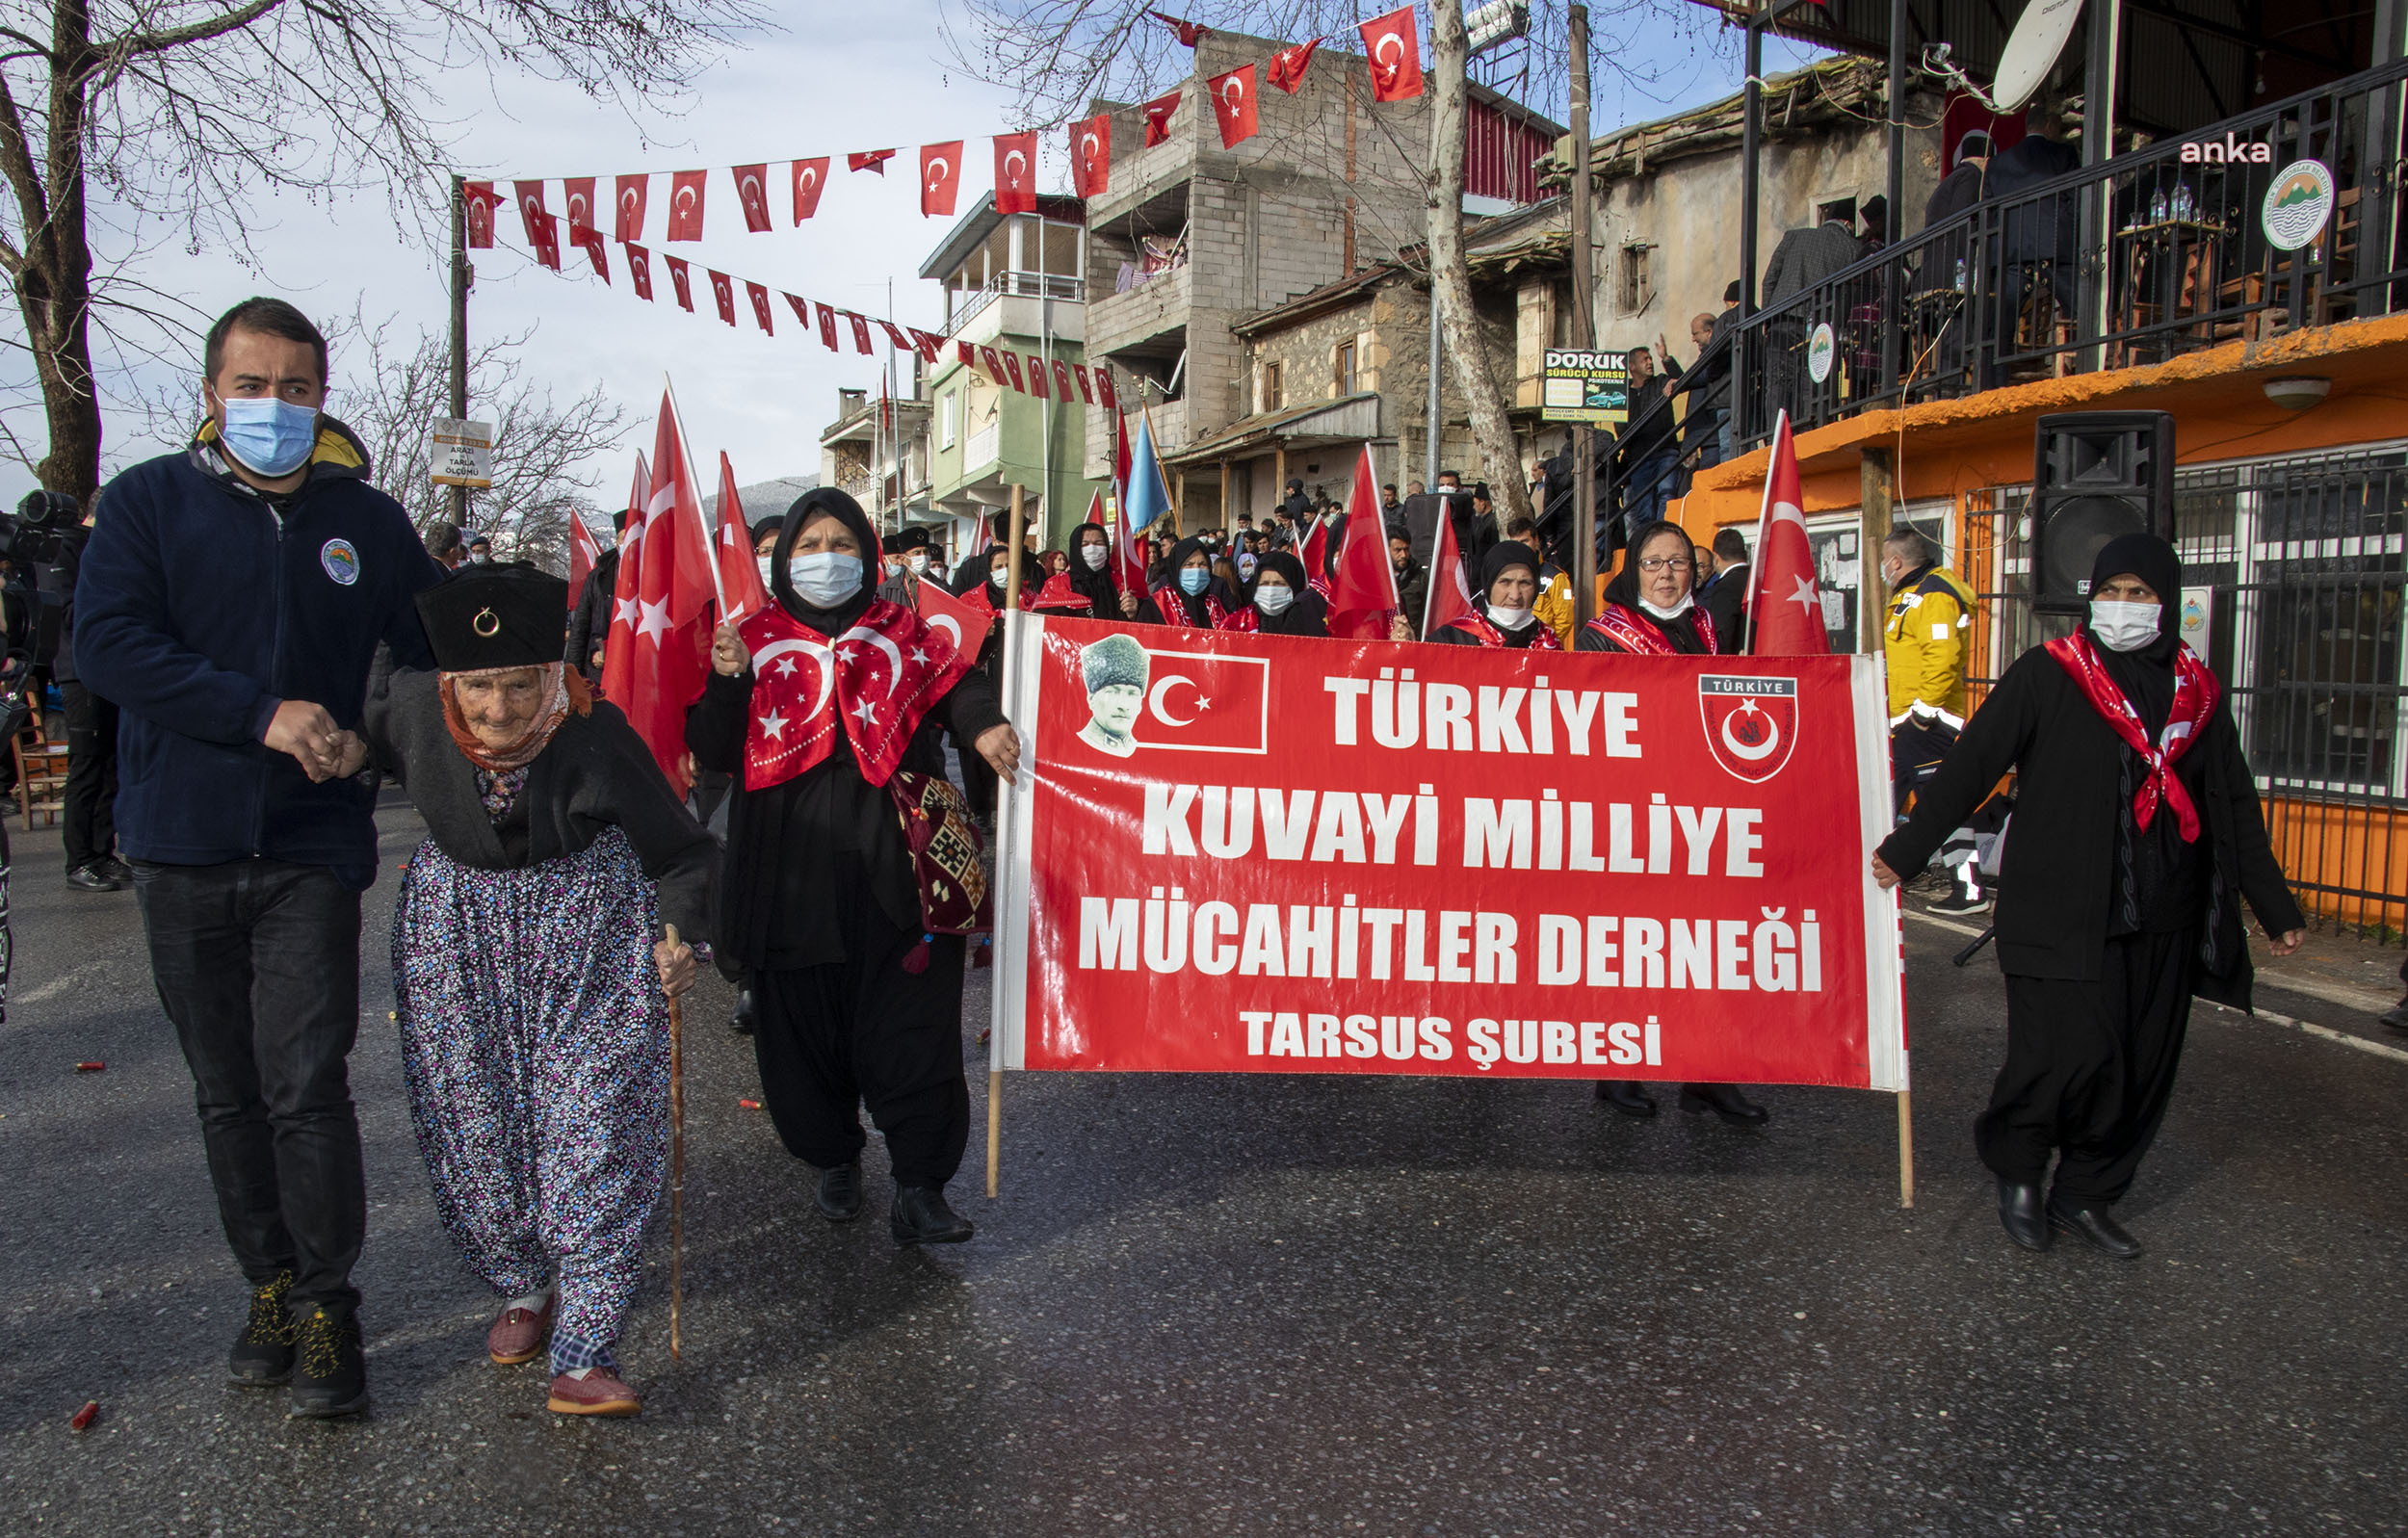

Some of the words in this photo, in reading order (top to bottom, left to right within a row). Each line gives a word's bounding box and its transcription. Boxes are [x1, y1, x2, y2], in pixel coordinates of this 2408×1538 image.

[1546, 352, 1626, 370] DORUK
[1546, 368, 1589, 378] SÜRÜCÜ
[450, 446, 474, 455] ARAZİ
[445, 467, 479, 476] ÖLÇÜMÜ
[1713, 679, 1784, 693] TÜRKİYE
[1324, 667, 1641, 758] TÜRKİYE
[1142, 783, 1438, 865] KUVAYİ
[1464, 789, 1764, 877] MİLLİYE
[1079, 885, 1517, 983] MÜCAHİTLER
[1538, 906, 1821, 992] DERNEĞİ
[1240, 1011, 1453, 1060] TARSUS
[1467, 1015, 1662, 1071] ŞUBESİ
